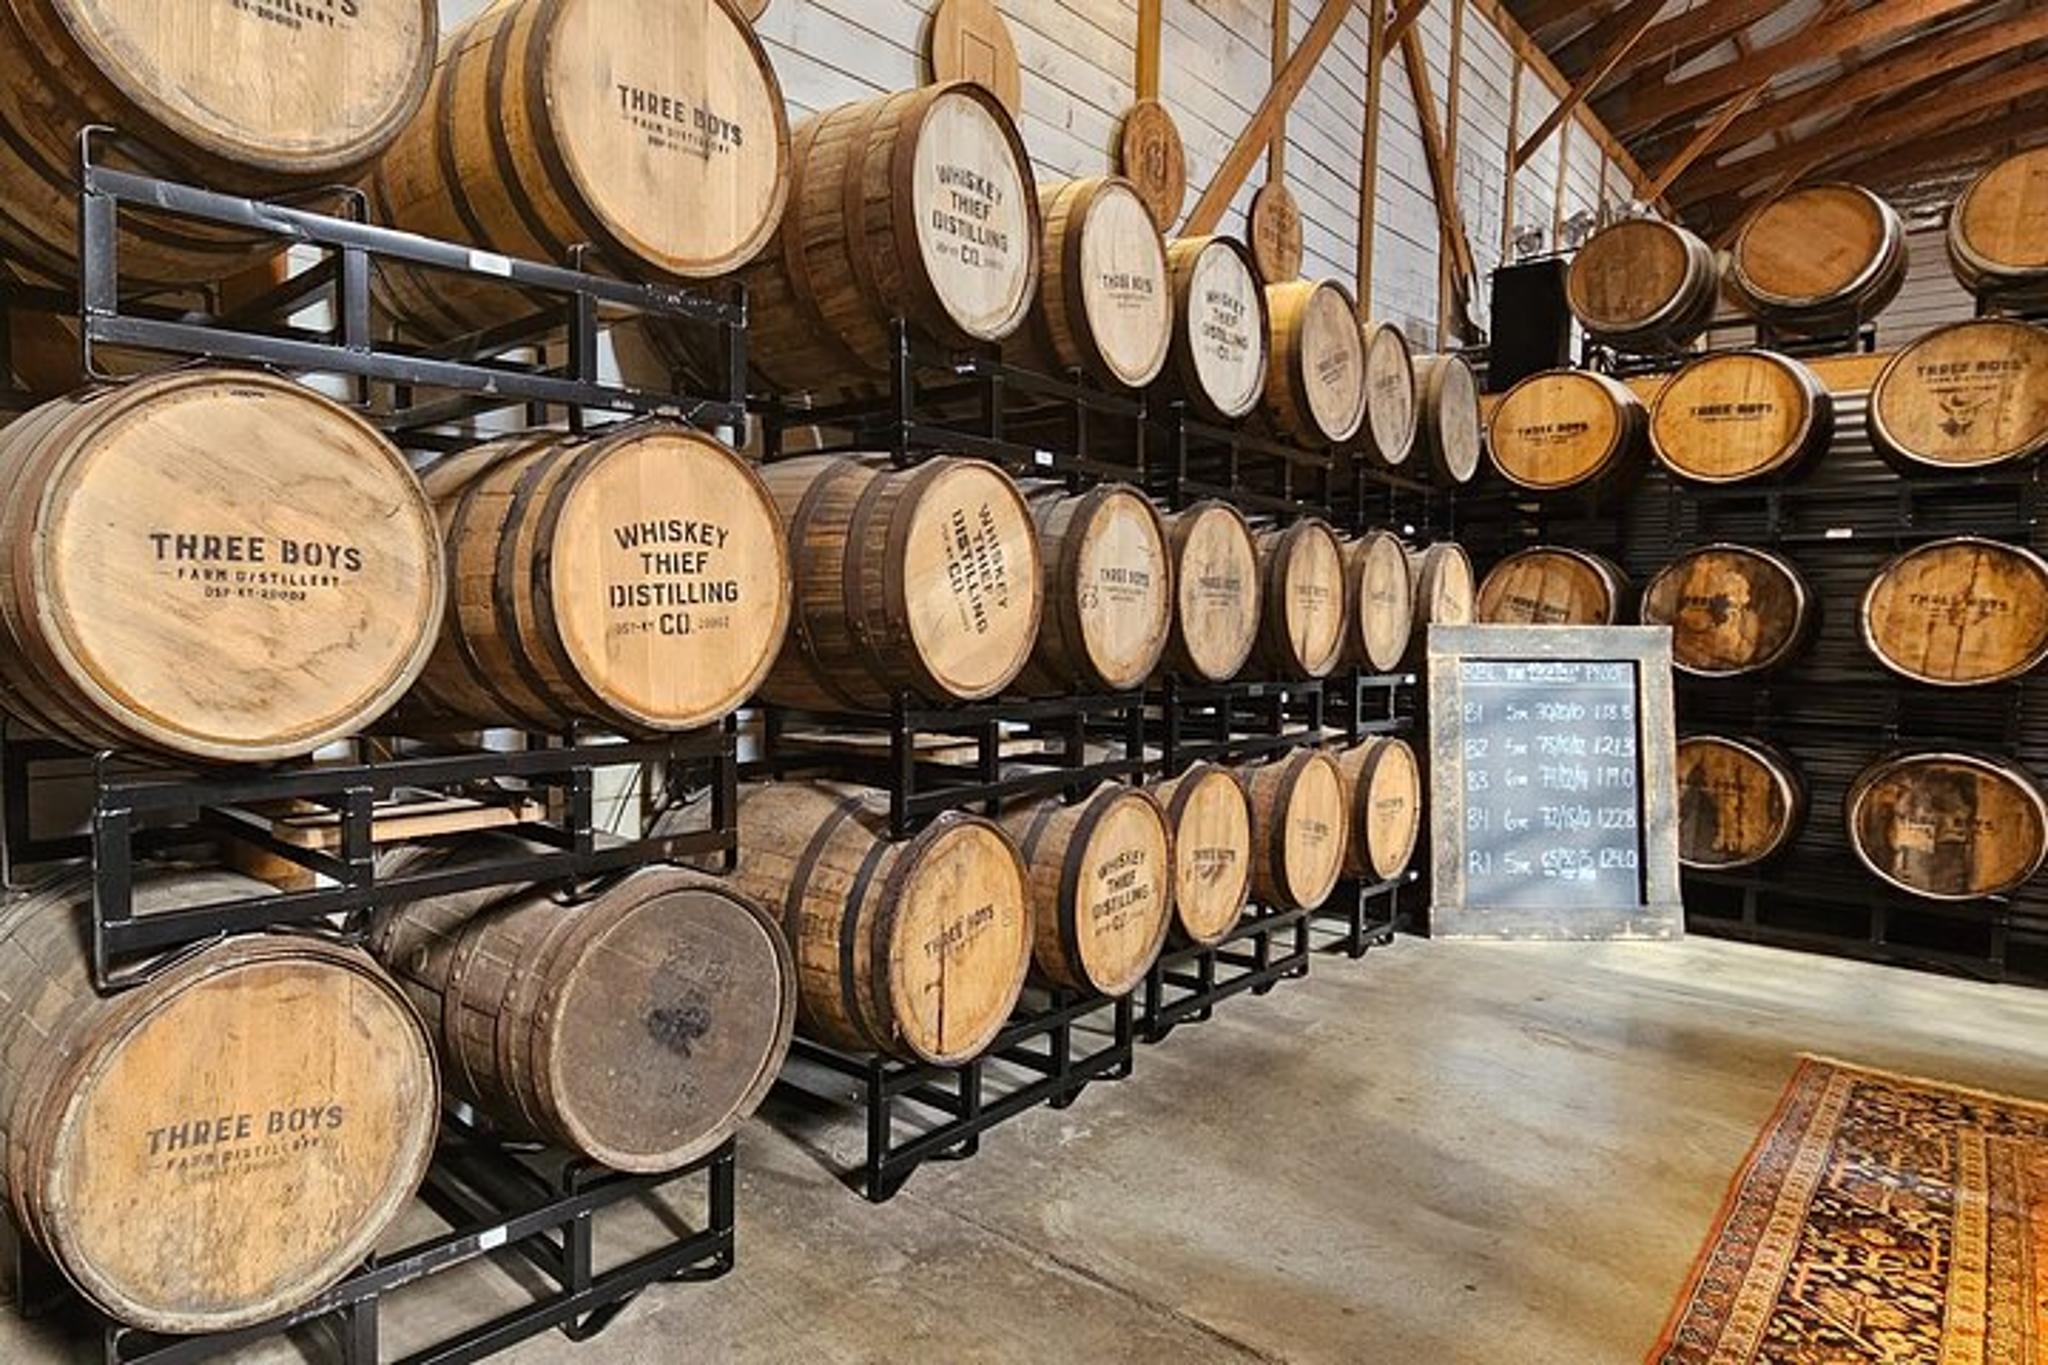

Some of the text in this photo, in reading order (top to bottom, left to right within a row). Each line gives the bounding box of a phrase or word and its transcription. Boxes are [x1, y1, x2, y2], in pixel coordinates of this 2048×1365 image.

[617, 84, 743, 147] THREE BOYS
[935, 163, 1003, 206] WHISKEY
[950, 190, 993, 221] THIEF
[932, 209, 1008, 254] DISTILLING
[148, 533, 363, 573] THREE BOYS
[614, 519, 730, 550] WHISKEY
[979, 502, 1008, 610] WHISKEY
[178, 567, 341, 588] FARM DISTILLERY
[640, 551, 709, 575] THIEF
[952, 508, 988, 635] DISTILLING
[973, 529, 994, 595] THIEF
[609, 579, 739, 609] DISTILLING
[146, 1105, 343, 1157] THREE BOYS
